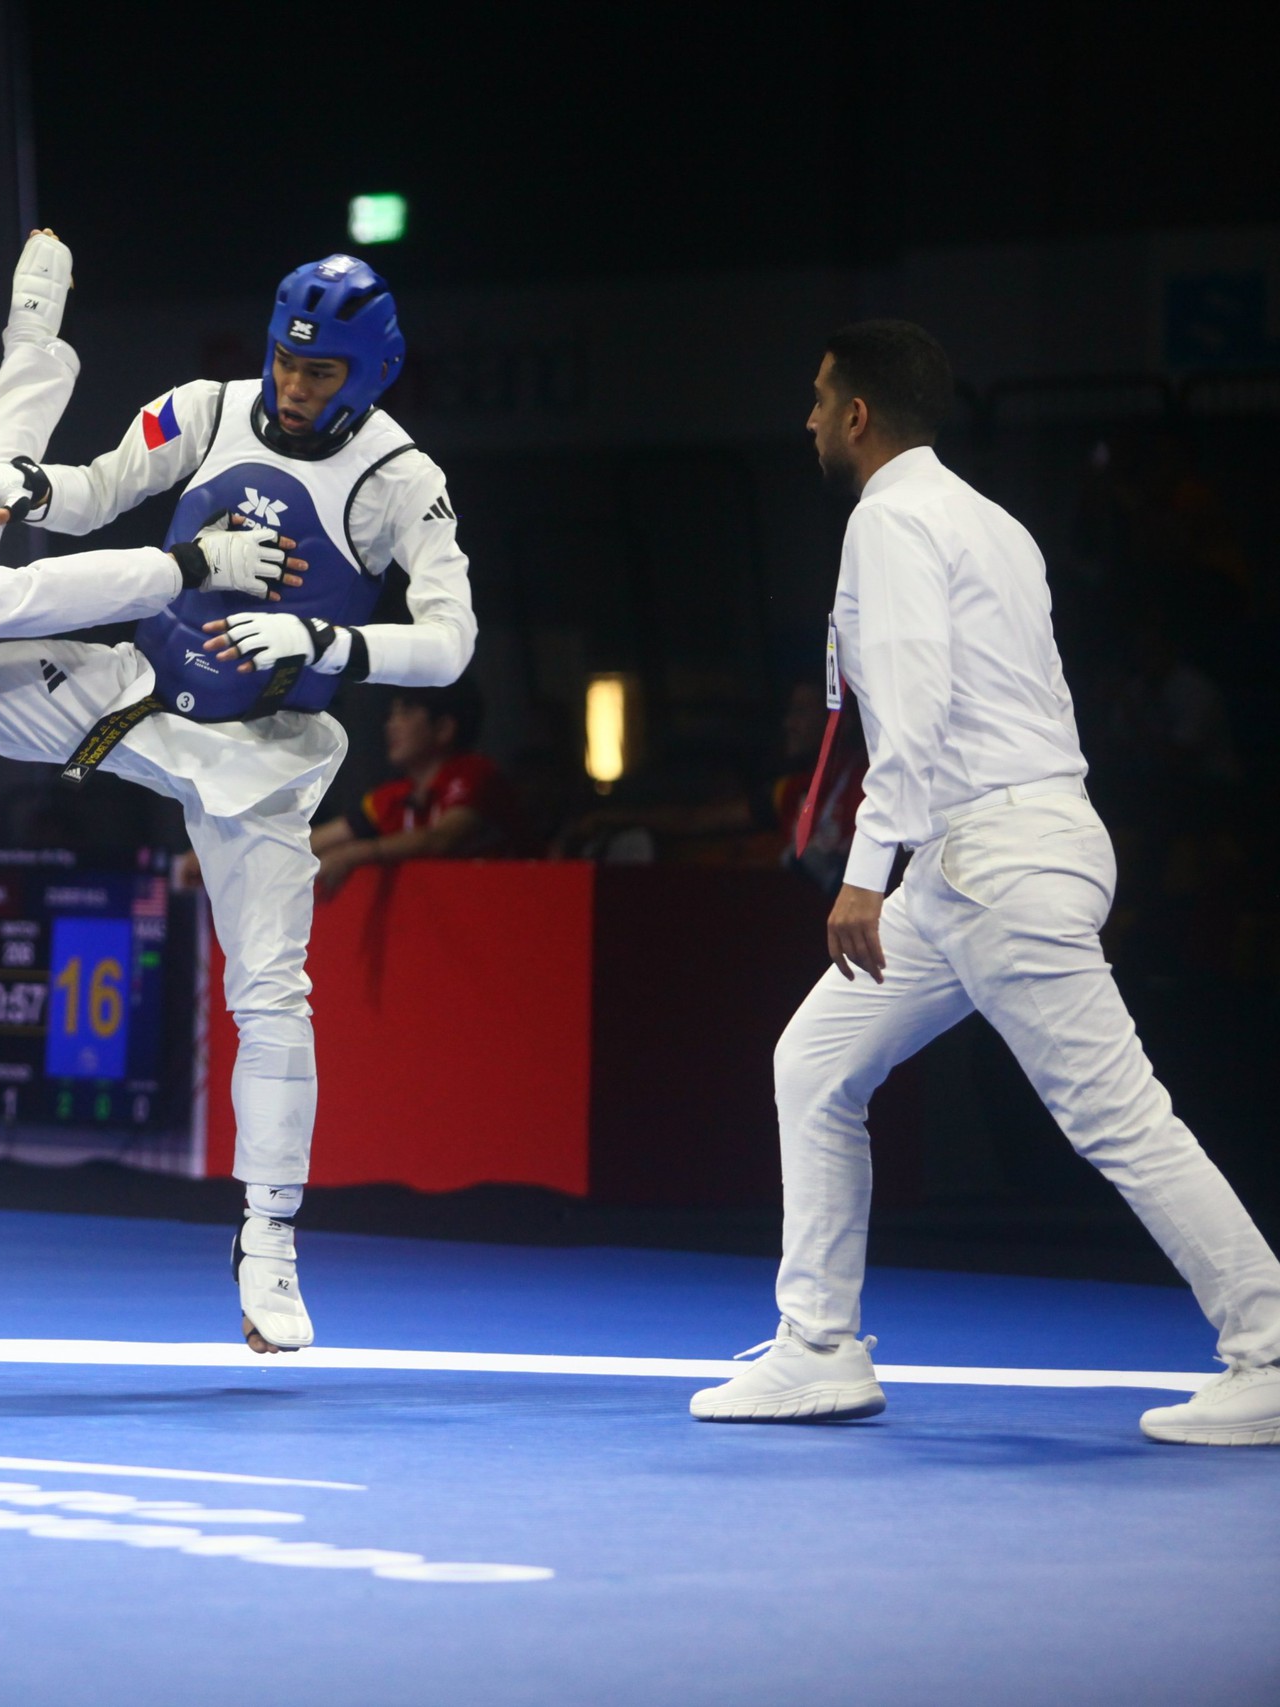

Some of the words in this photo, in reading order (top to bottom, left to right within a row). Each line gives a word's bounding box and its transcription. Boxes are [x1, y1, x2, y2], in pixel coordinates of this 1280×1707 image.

[180, 695, 190, 709] 3
[53, 956, 124, 1038] 16
[277, 1278, 290, 1291] K2
